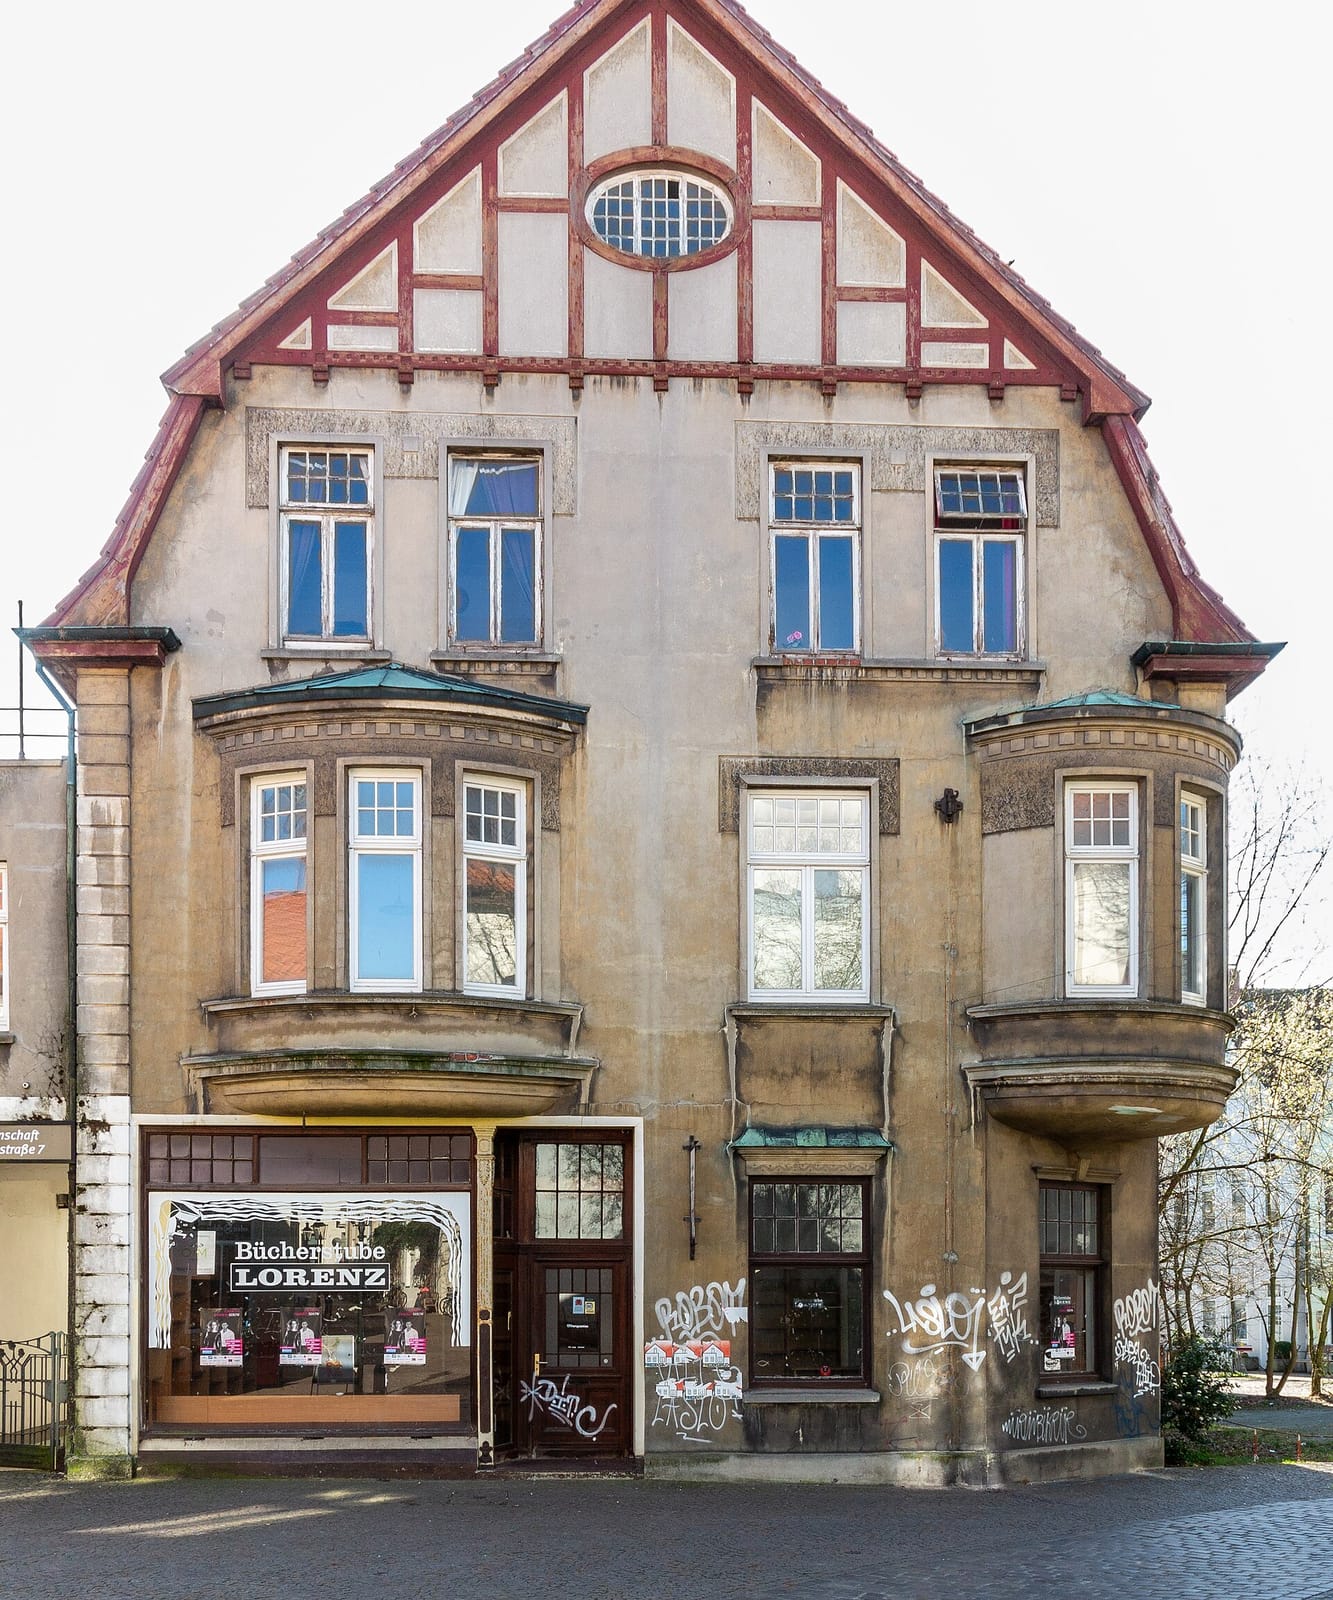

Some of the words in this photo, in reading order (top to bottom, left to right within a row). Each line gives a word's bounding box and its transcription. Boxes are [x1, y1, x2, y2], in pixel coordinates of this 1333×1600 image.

[38, 1144, 46, 1155] 7
[234, 1241, 386, 1260] Bücherstube
[235, 1268, 386, 1287] LORENZ
